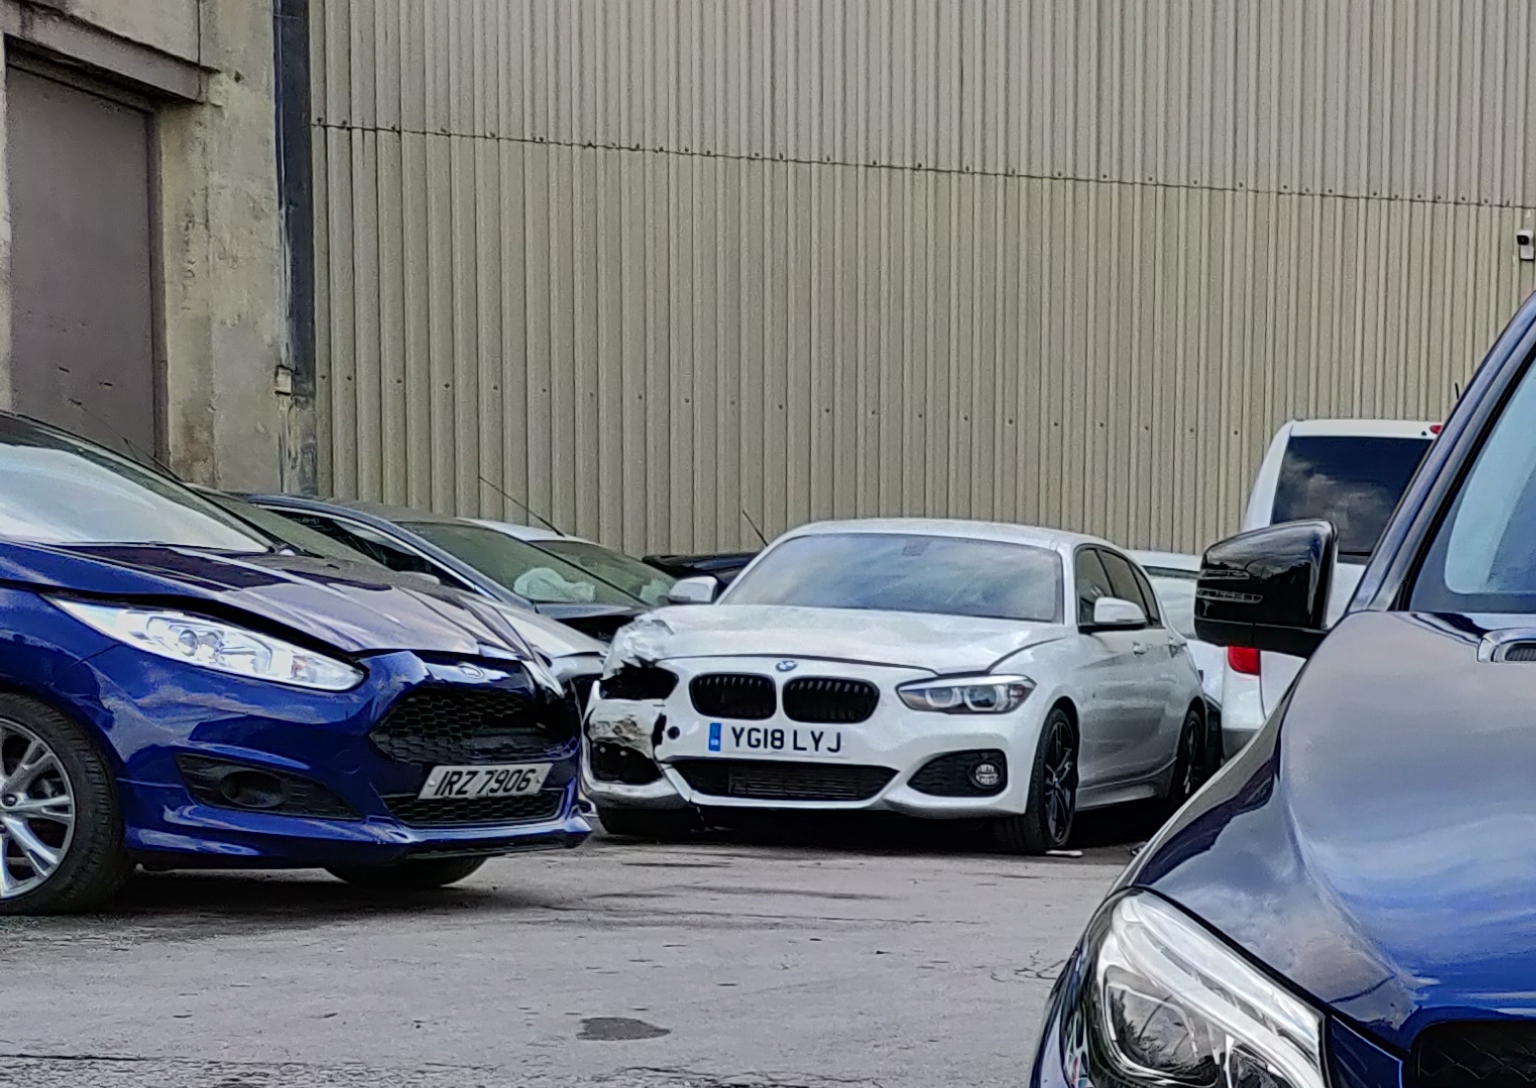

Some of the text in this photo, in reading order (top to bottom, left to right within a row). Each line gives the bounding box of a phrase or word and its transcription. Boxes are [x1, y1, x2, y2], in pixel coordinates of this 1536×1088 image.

[731, 726, 841, 753] YG18 LYJ
[434, 768, 537, 796] IRZ 7906
